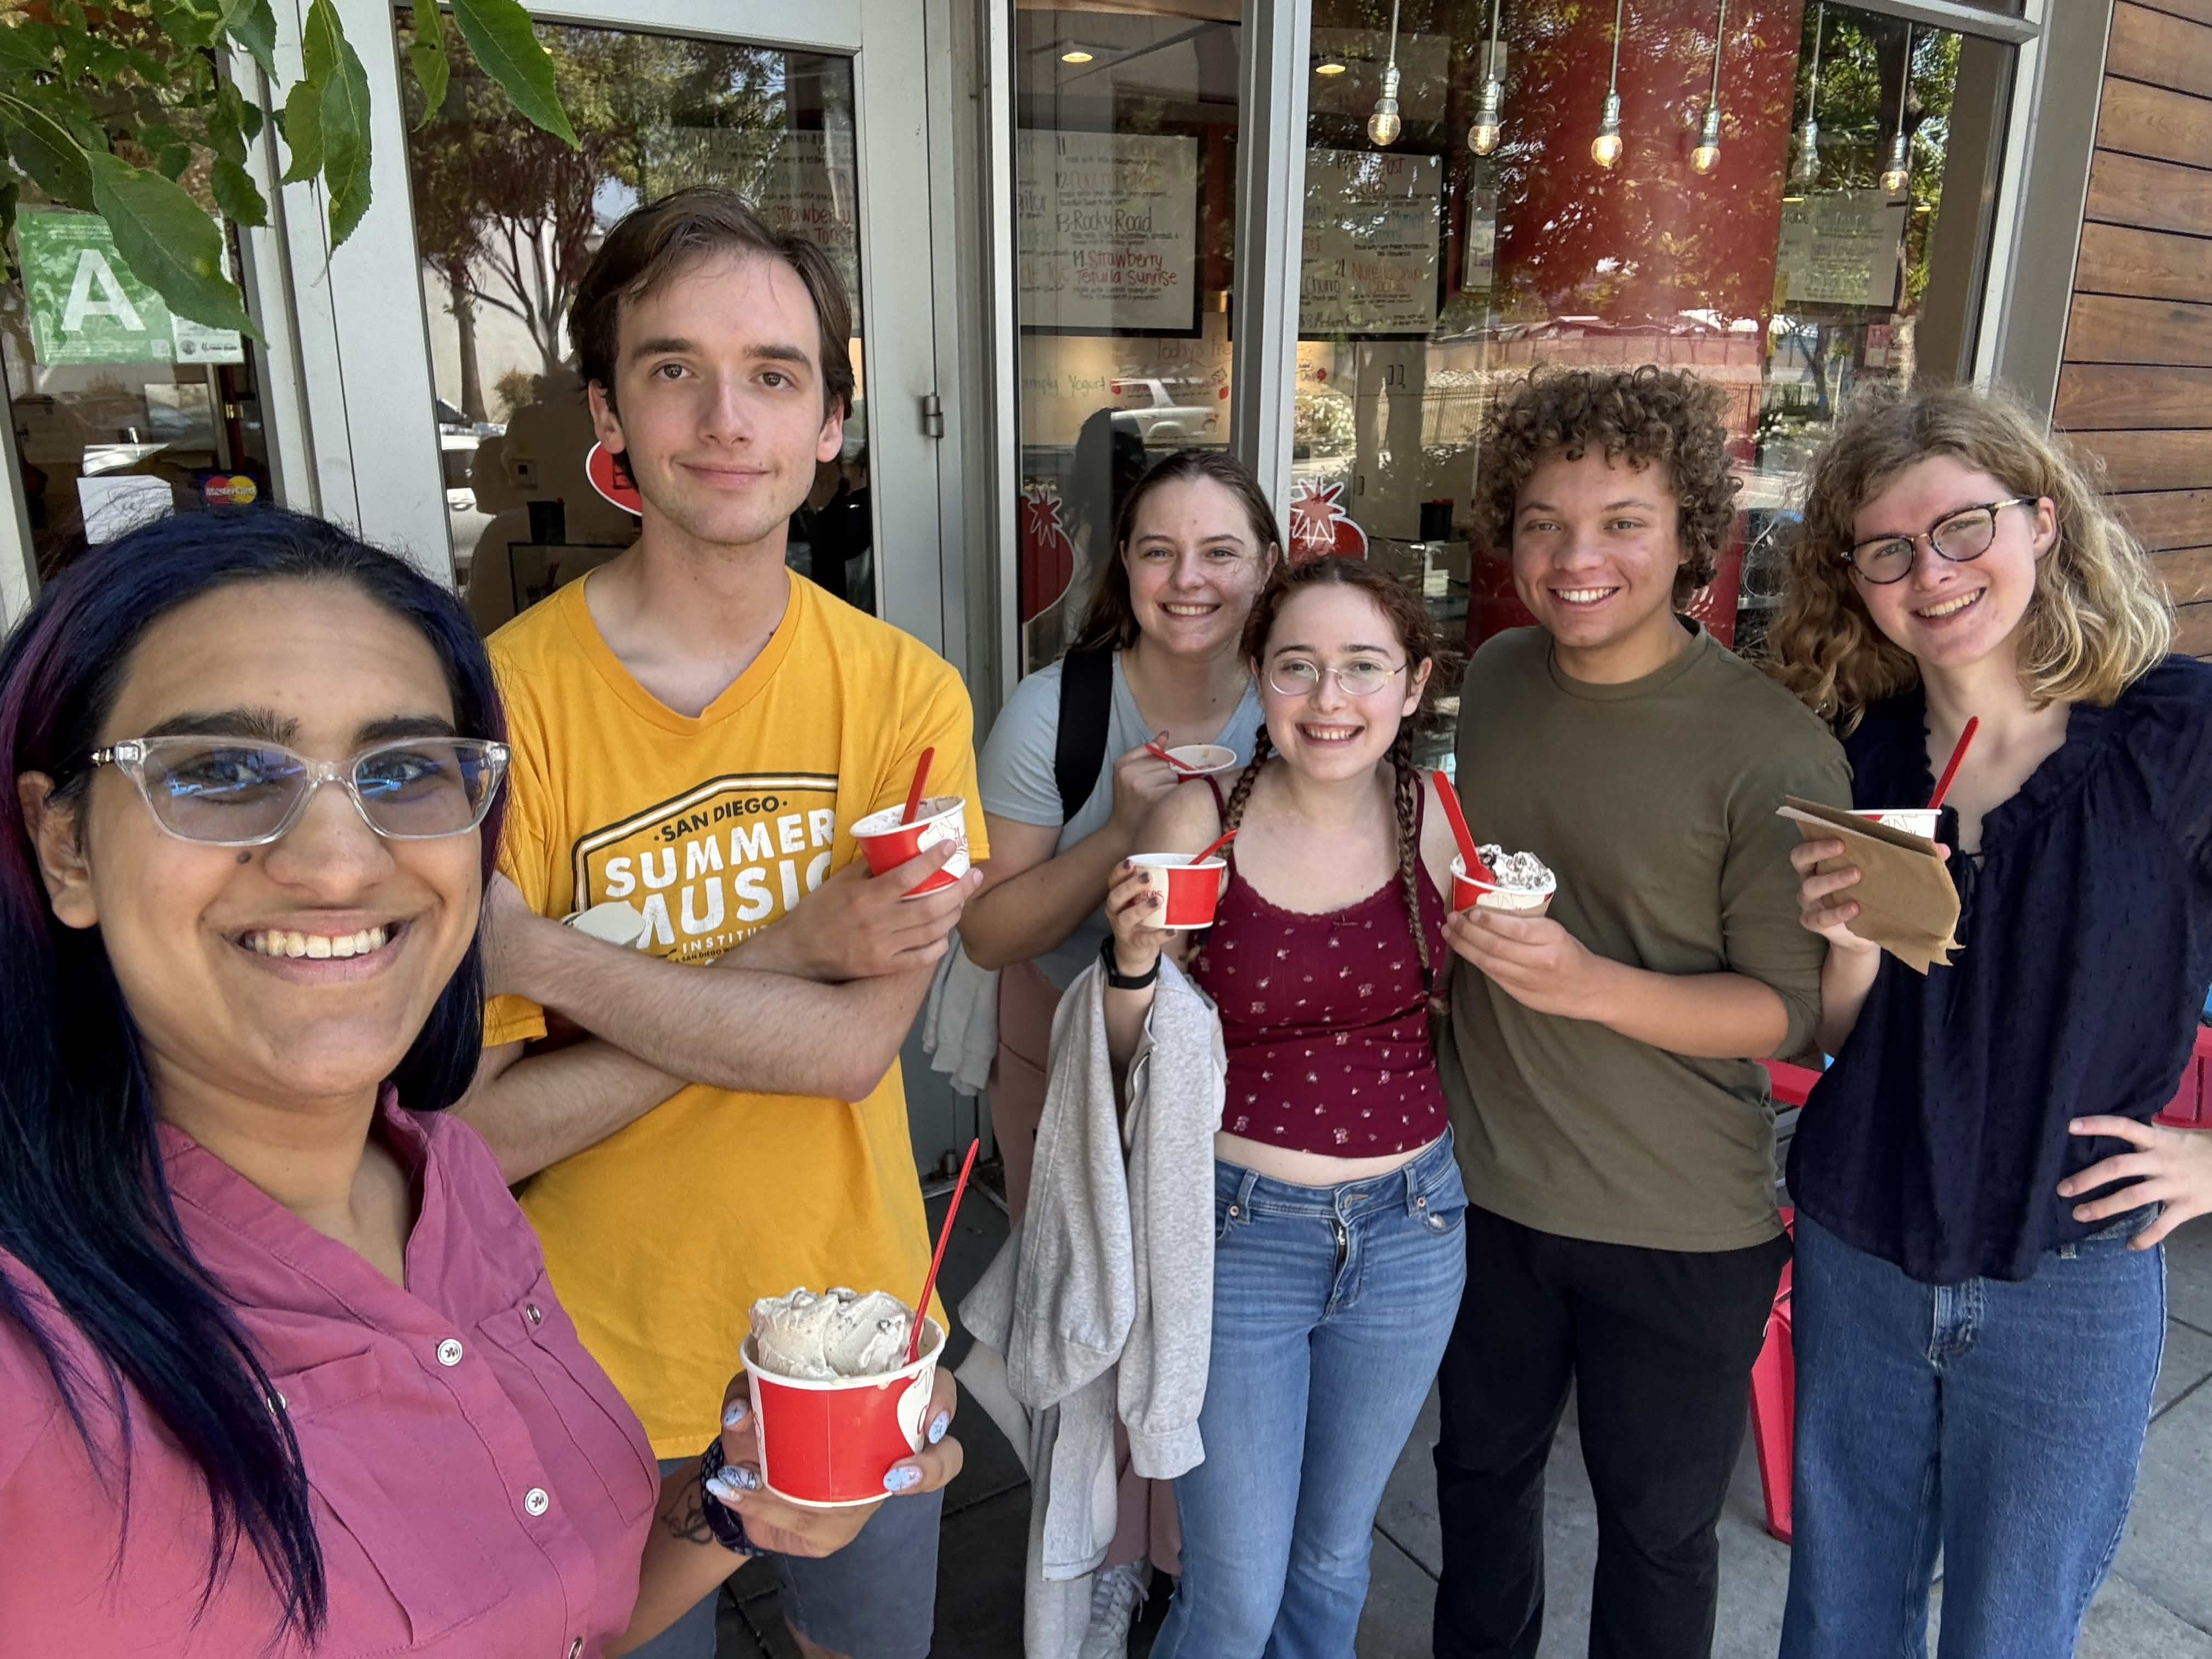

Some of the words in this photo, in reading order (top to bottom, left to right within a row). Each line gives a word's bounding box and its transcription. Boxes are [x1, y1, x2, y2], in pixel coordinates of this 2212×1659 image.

[1074, 208, 1113, 232] Rocky
[1114, 207, 1153, 232] Road
[1076, 268, 1122, 285] Tequila
[1127, 270, 1178, 286] Sunrise
[1088, 248, 1163, 271] Strawberry
[61, 249, 145, 331] A
[661, 811, 709, 843] SAN
[713, 794, 780, 823] DIEGO
[605, 808, 834, 898] SUMMER
